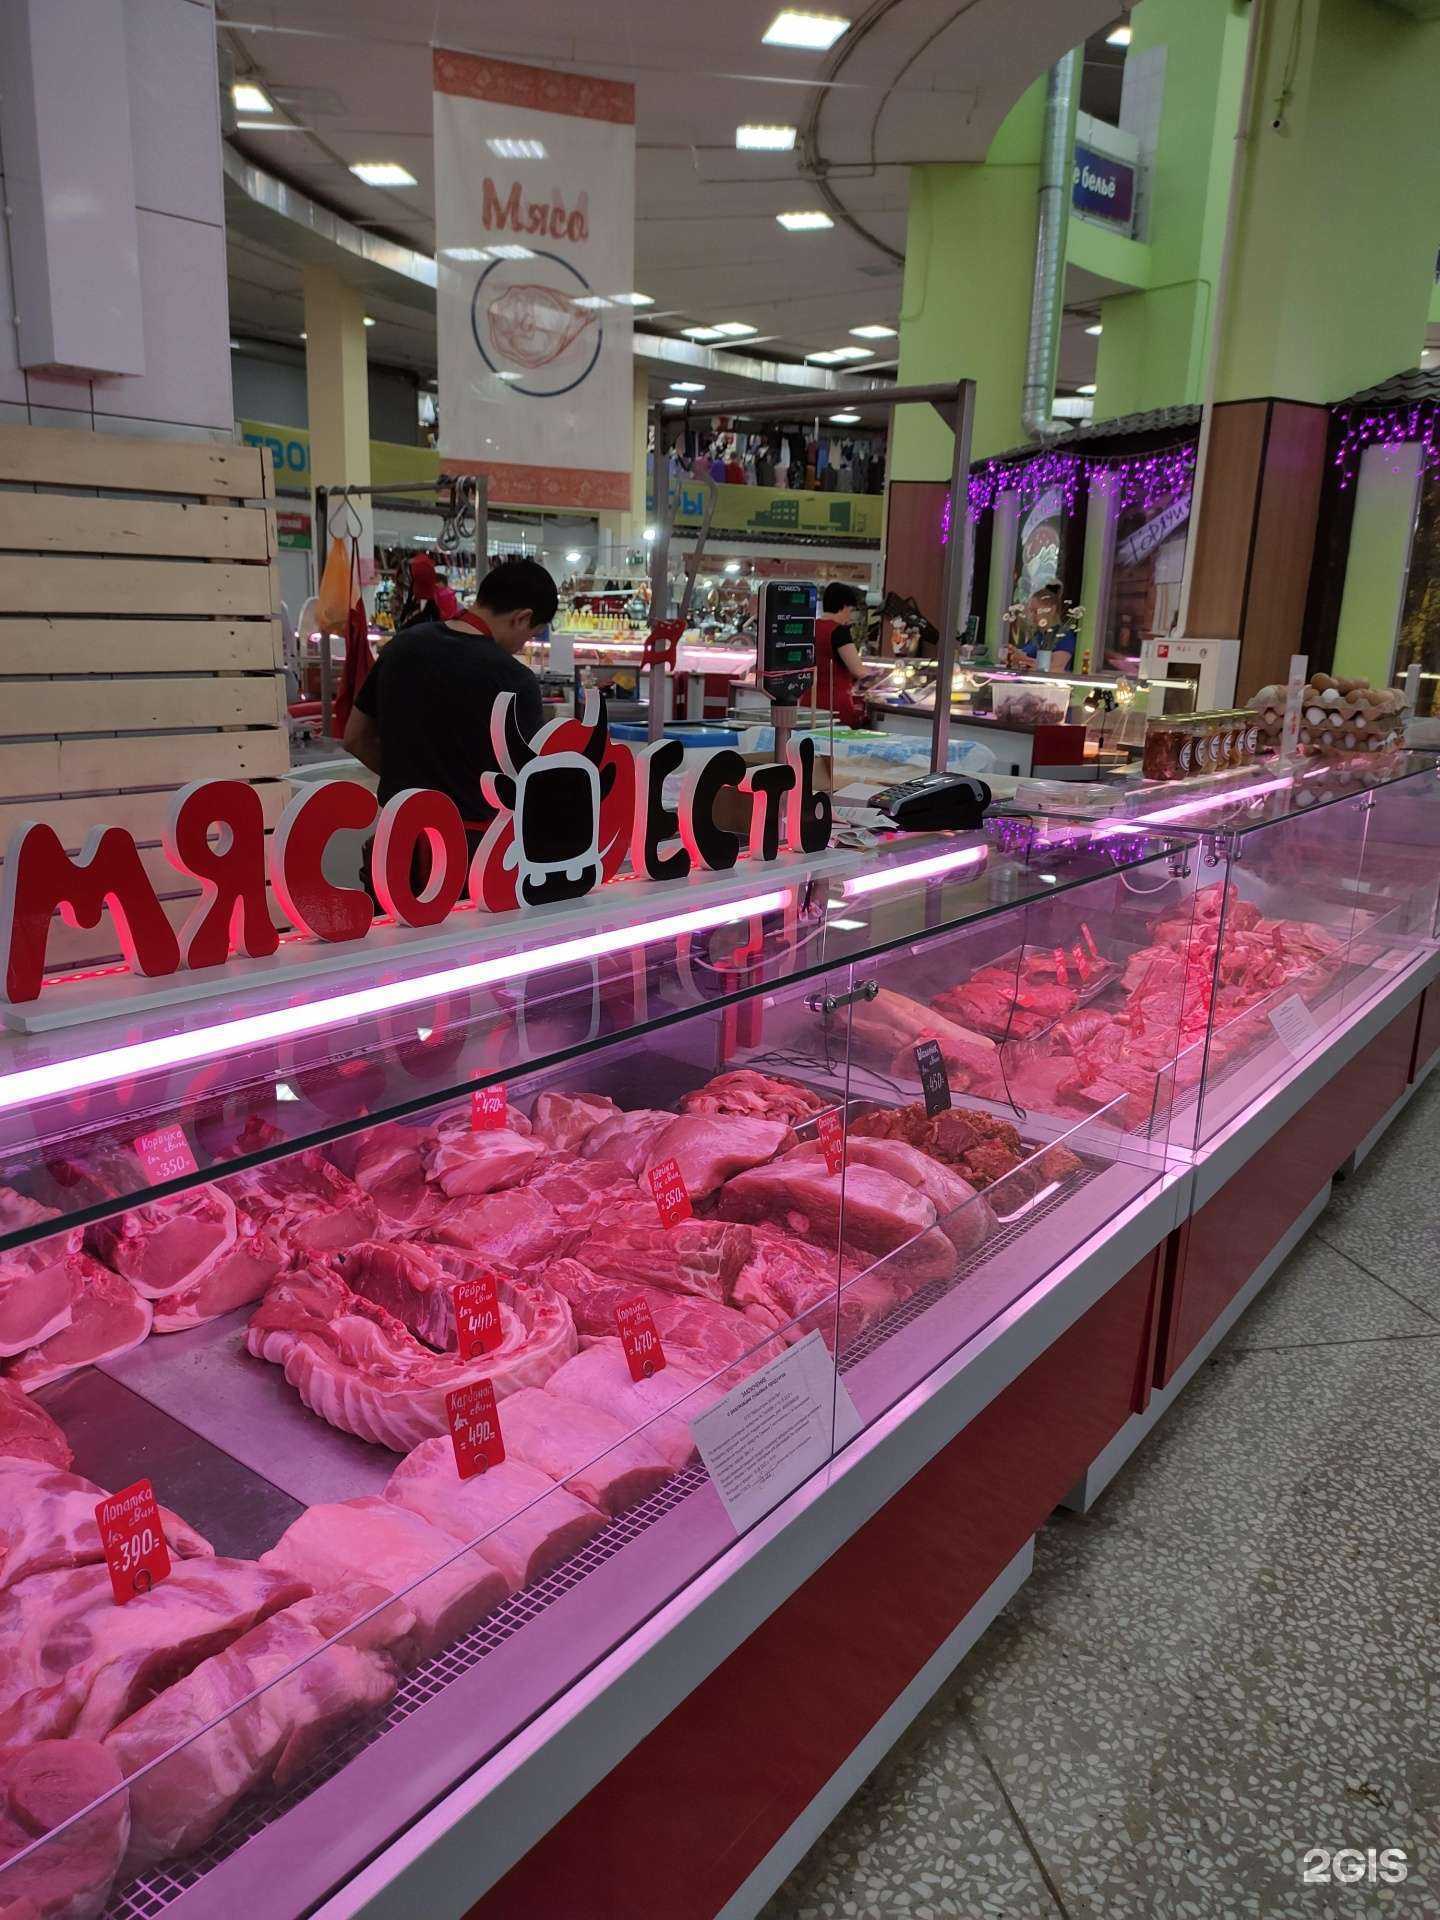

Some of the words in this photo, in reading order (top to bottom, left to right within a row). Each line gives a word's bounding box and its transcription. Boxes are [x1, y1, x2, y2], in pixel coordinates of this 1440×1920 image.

[1081, 165, 1117, 198] бельё
[482, 177, 589, 242] Мясо
[3, 777, 469, 1004] МЯСО
[632, 737, 832, 881] ЕСТЬ
[102, 1488, 153, 1526] Лопатка
